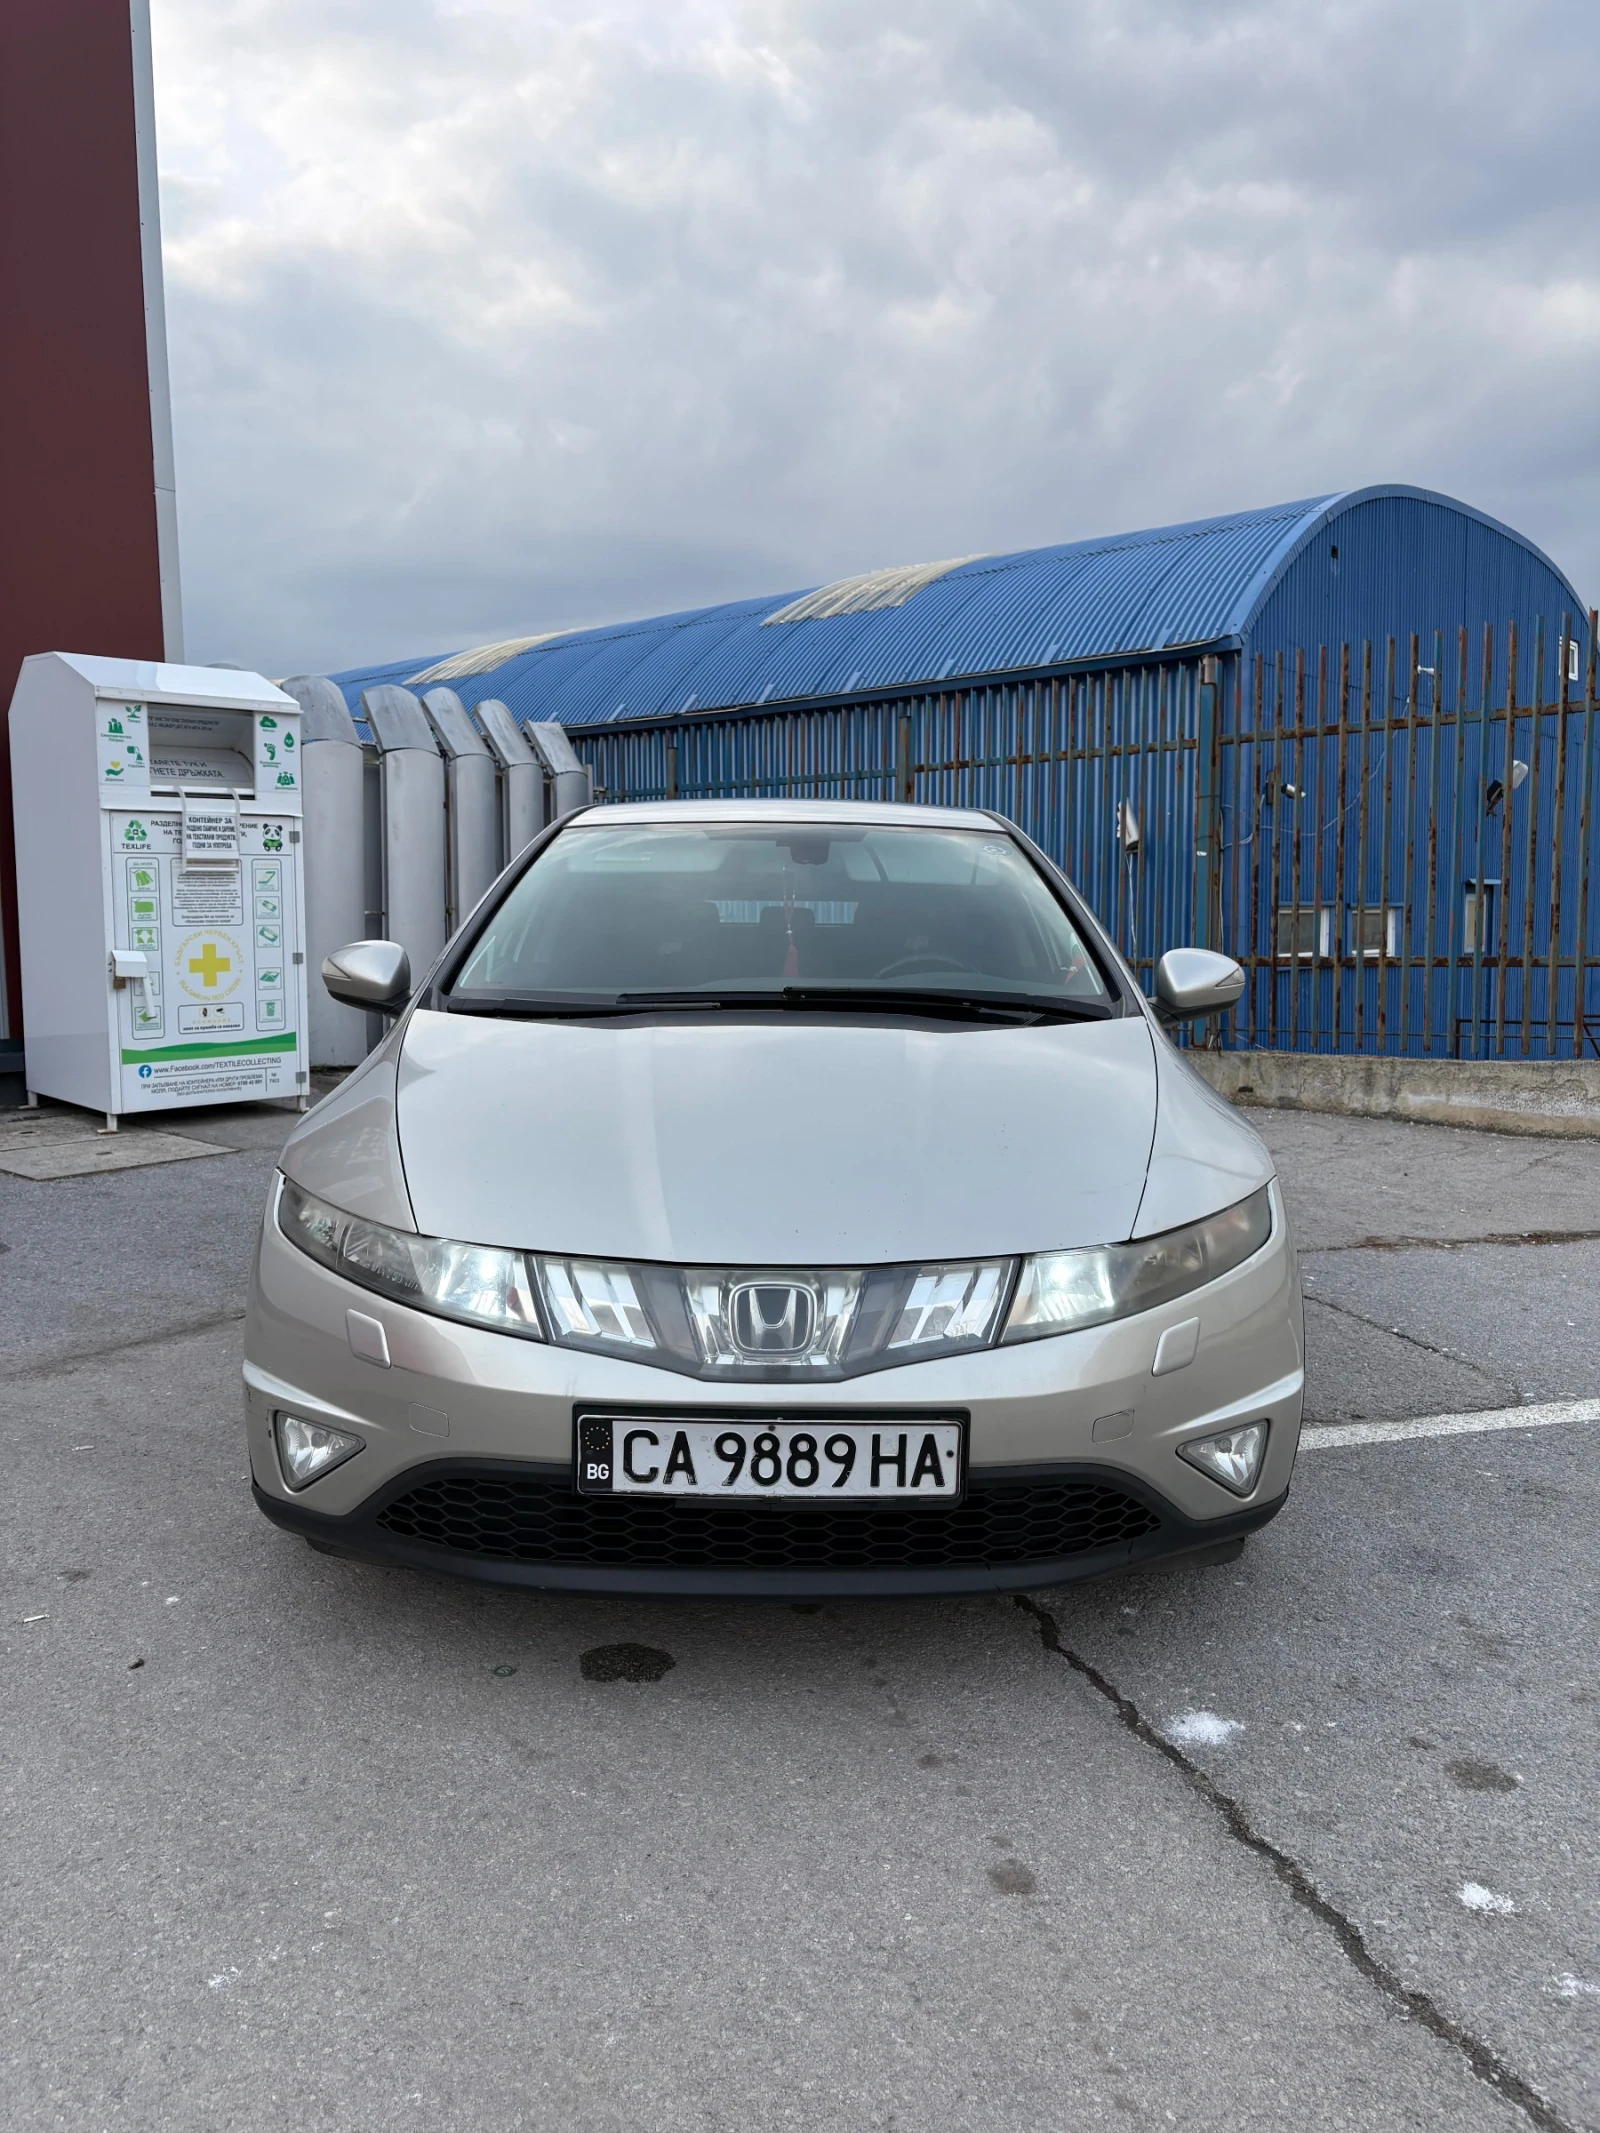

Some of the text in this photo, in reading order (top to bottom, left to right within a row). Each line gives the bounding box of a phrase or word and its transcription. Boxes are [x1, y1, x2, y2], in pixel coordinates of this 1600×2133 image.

[188, 816, 222, 824] КОНТЕЙНЕР
[174, 928, 244, 966] БЪЛГАРСКИ ЧЕРВЕН КРЪСТ
[178, 978, 240, 1001] BULGARIAN RED CROSS
[622, 1429, 946, 1488] CA 9889 HA
[586, 1463, 610, 1480] BG
